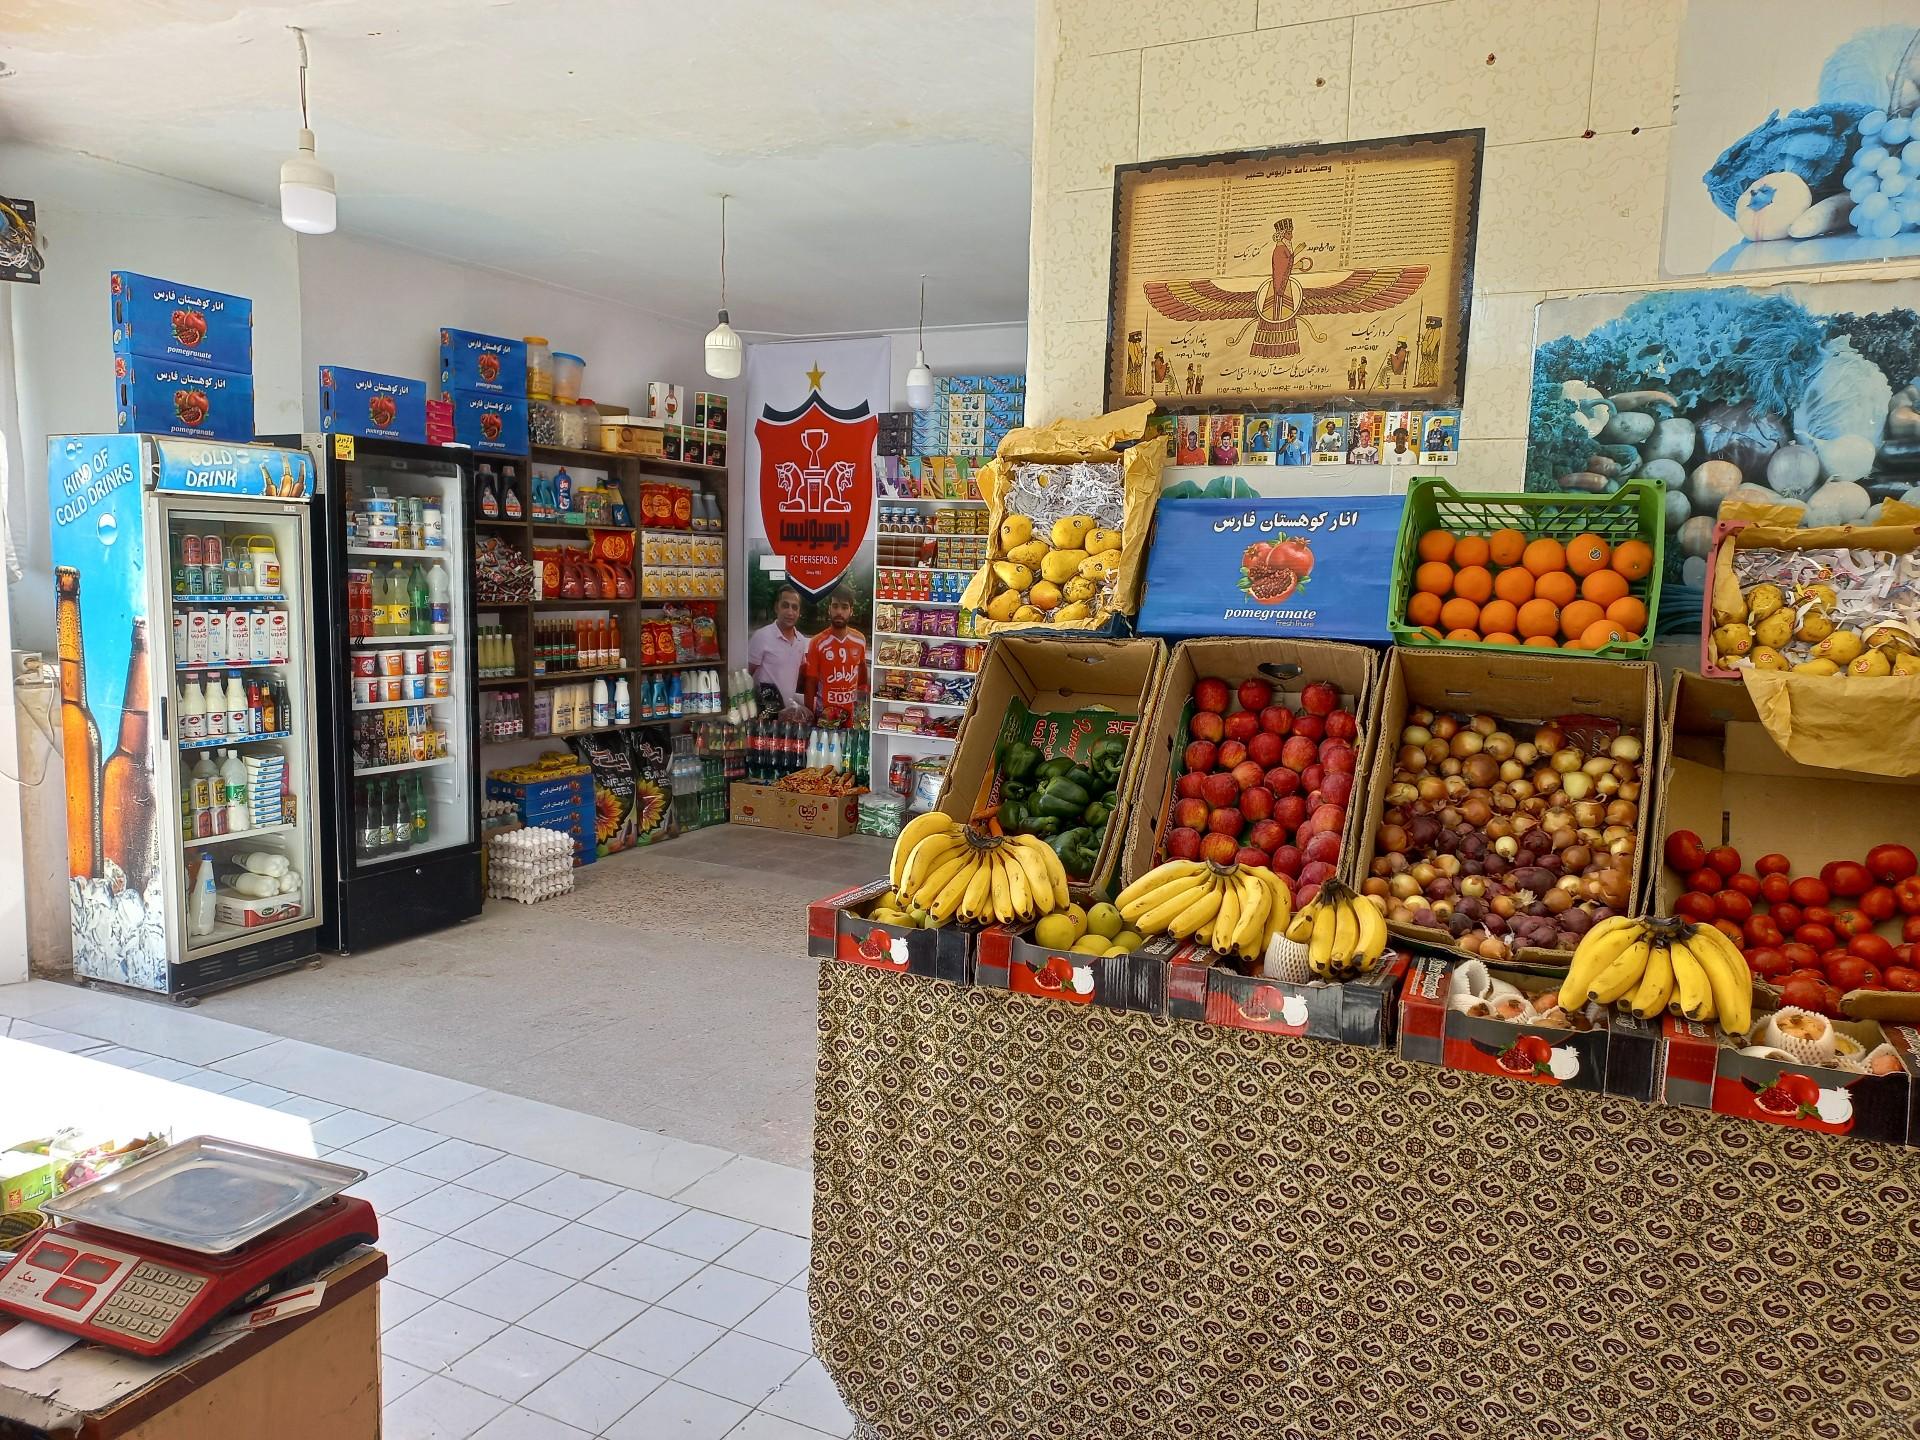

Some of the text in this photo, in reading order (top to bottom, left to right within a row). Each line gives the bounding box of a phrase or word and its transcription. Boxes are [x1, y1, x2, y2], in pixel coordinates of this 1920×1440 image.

[153, 289, 224, 312] انار کوهستان فارس
[167, 346, 212, 360] pomegranate
[156, 370, 226, 390] انار کوهستان فارس
[355, 379, 409, 395] انار کوهستان فارس
[170, 425, 215, 437] pomegranate
[92, 448, 110, 473] OF
[190, 450, 233, 467] COLD
[185, 469, 238, 489] DRINK
[56, 463, 134, 526] COLD DRINKS
[1213, 510, 1358, 532] انار کوهستان فارس
[790, 555, 838, 565] FC PERSEPOLIS
[1224, 608, 1317, 621] pomegranate
